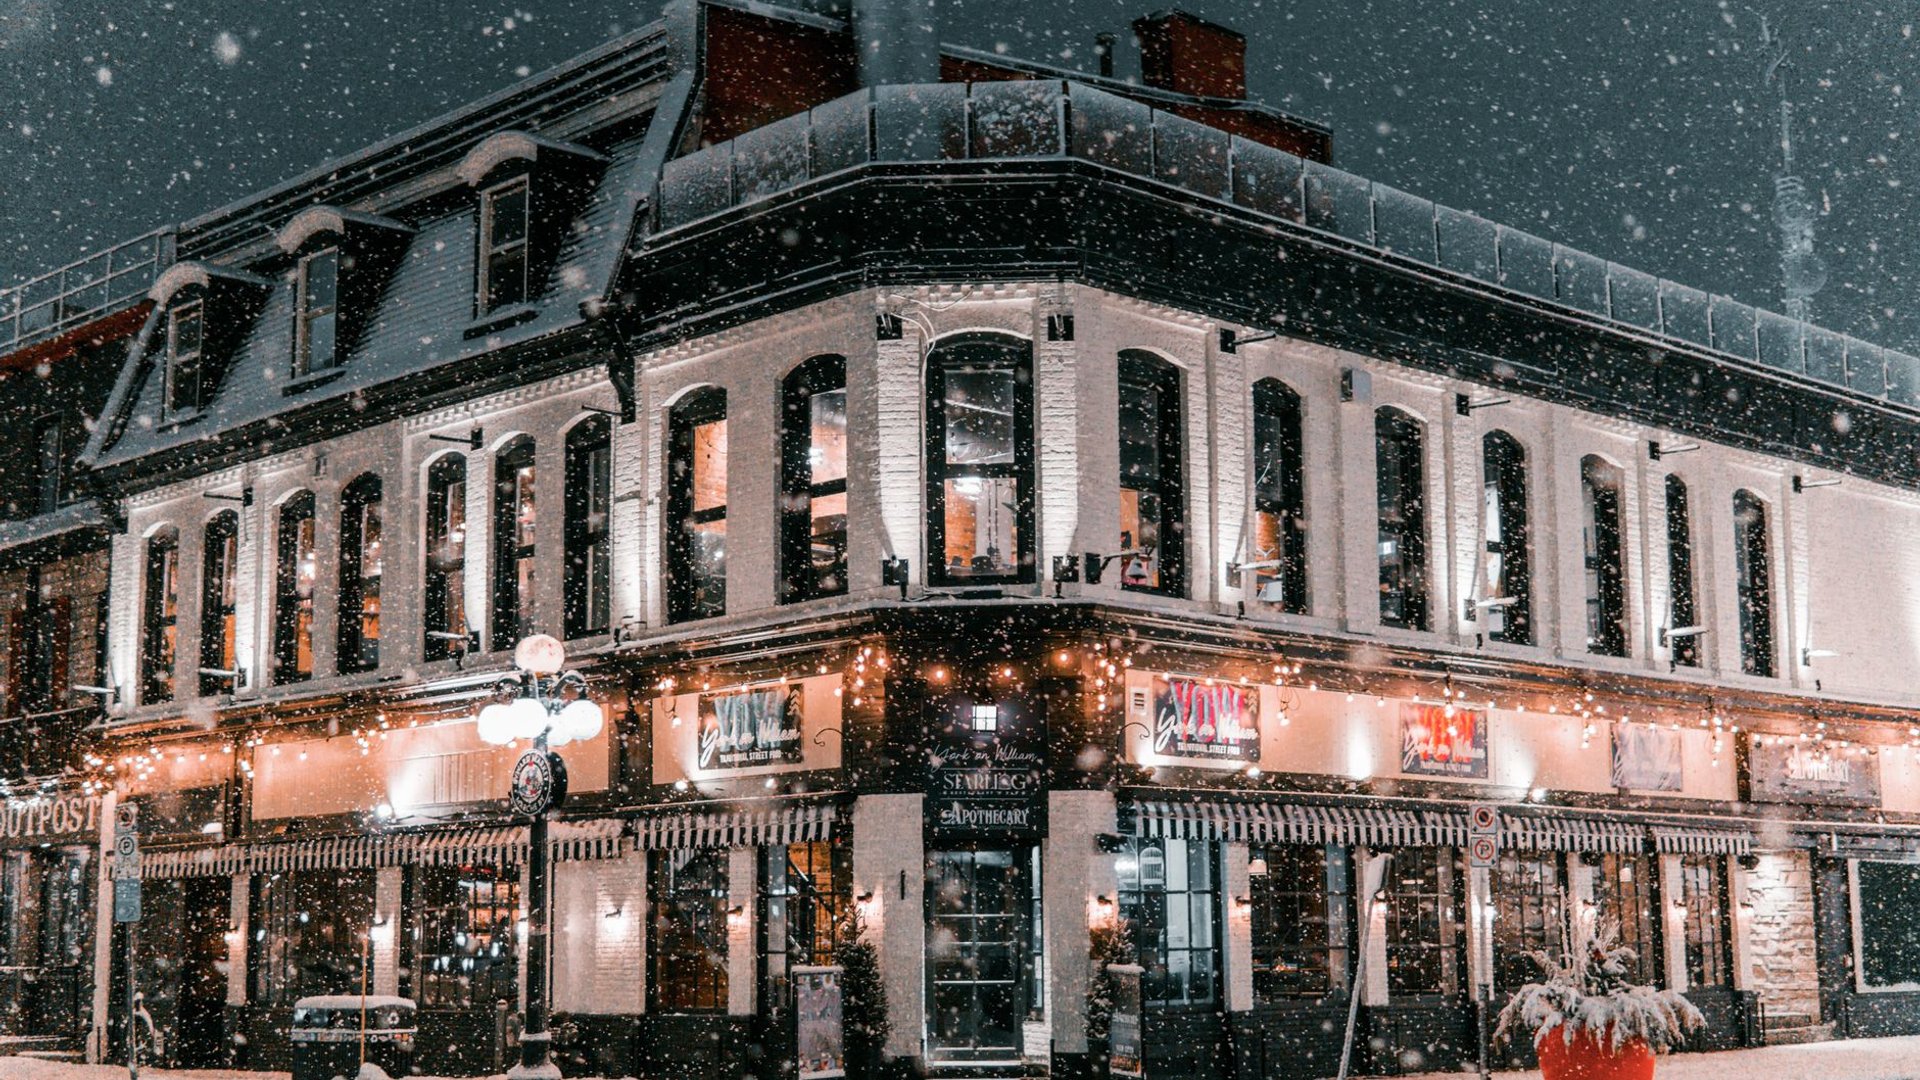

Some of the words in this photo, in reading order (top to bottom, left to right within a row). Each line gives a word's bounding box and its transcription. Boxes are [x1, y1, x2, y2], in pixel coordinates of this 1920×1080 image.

[931, 744, 971, 773] York
[994, 742, 1038, 761] William
[943, 773, 1026, 790] STARLIG
